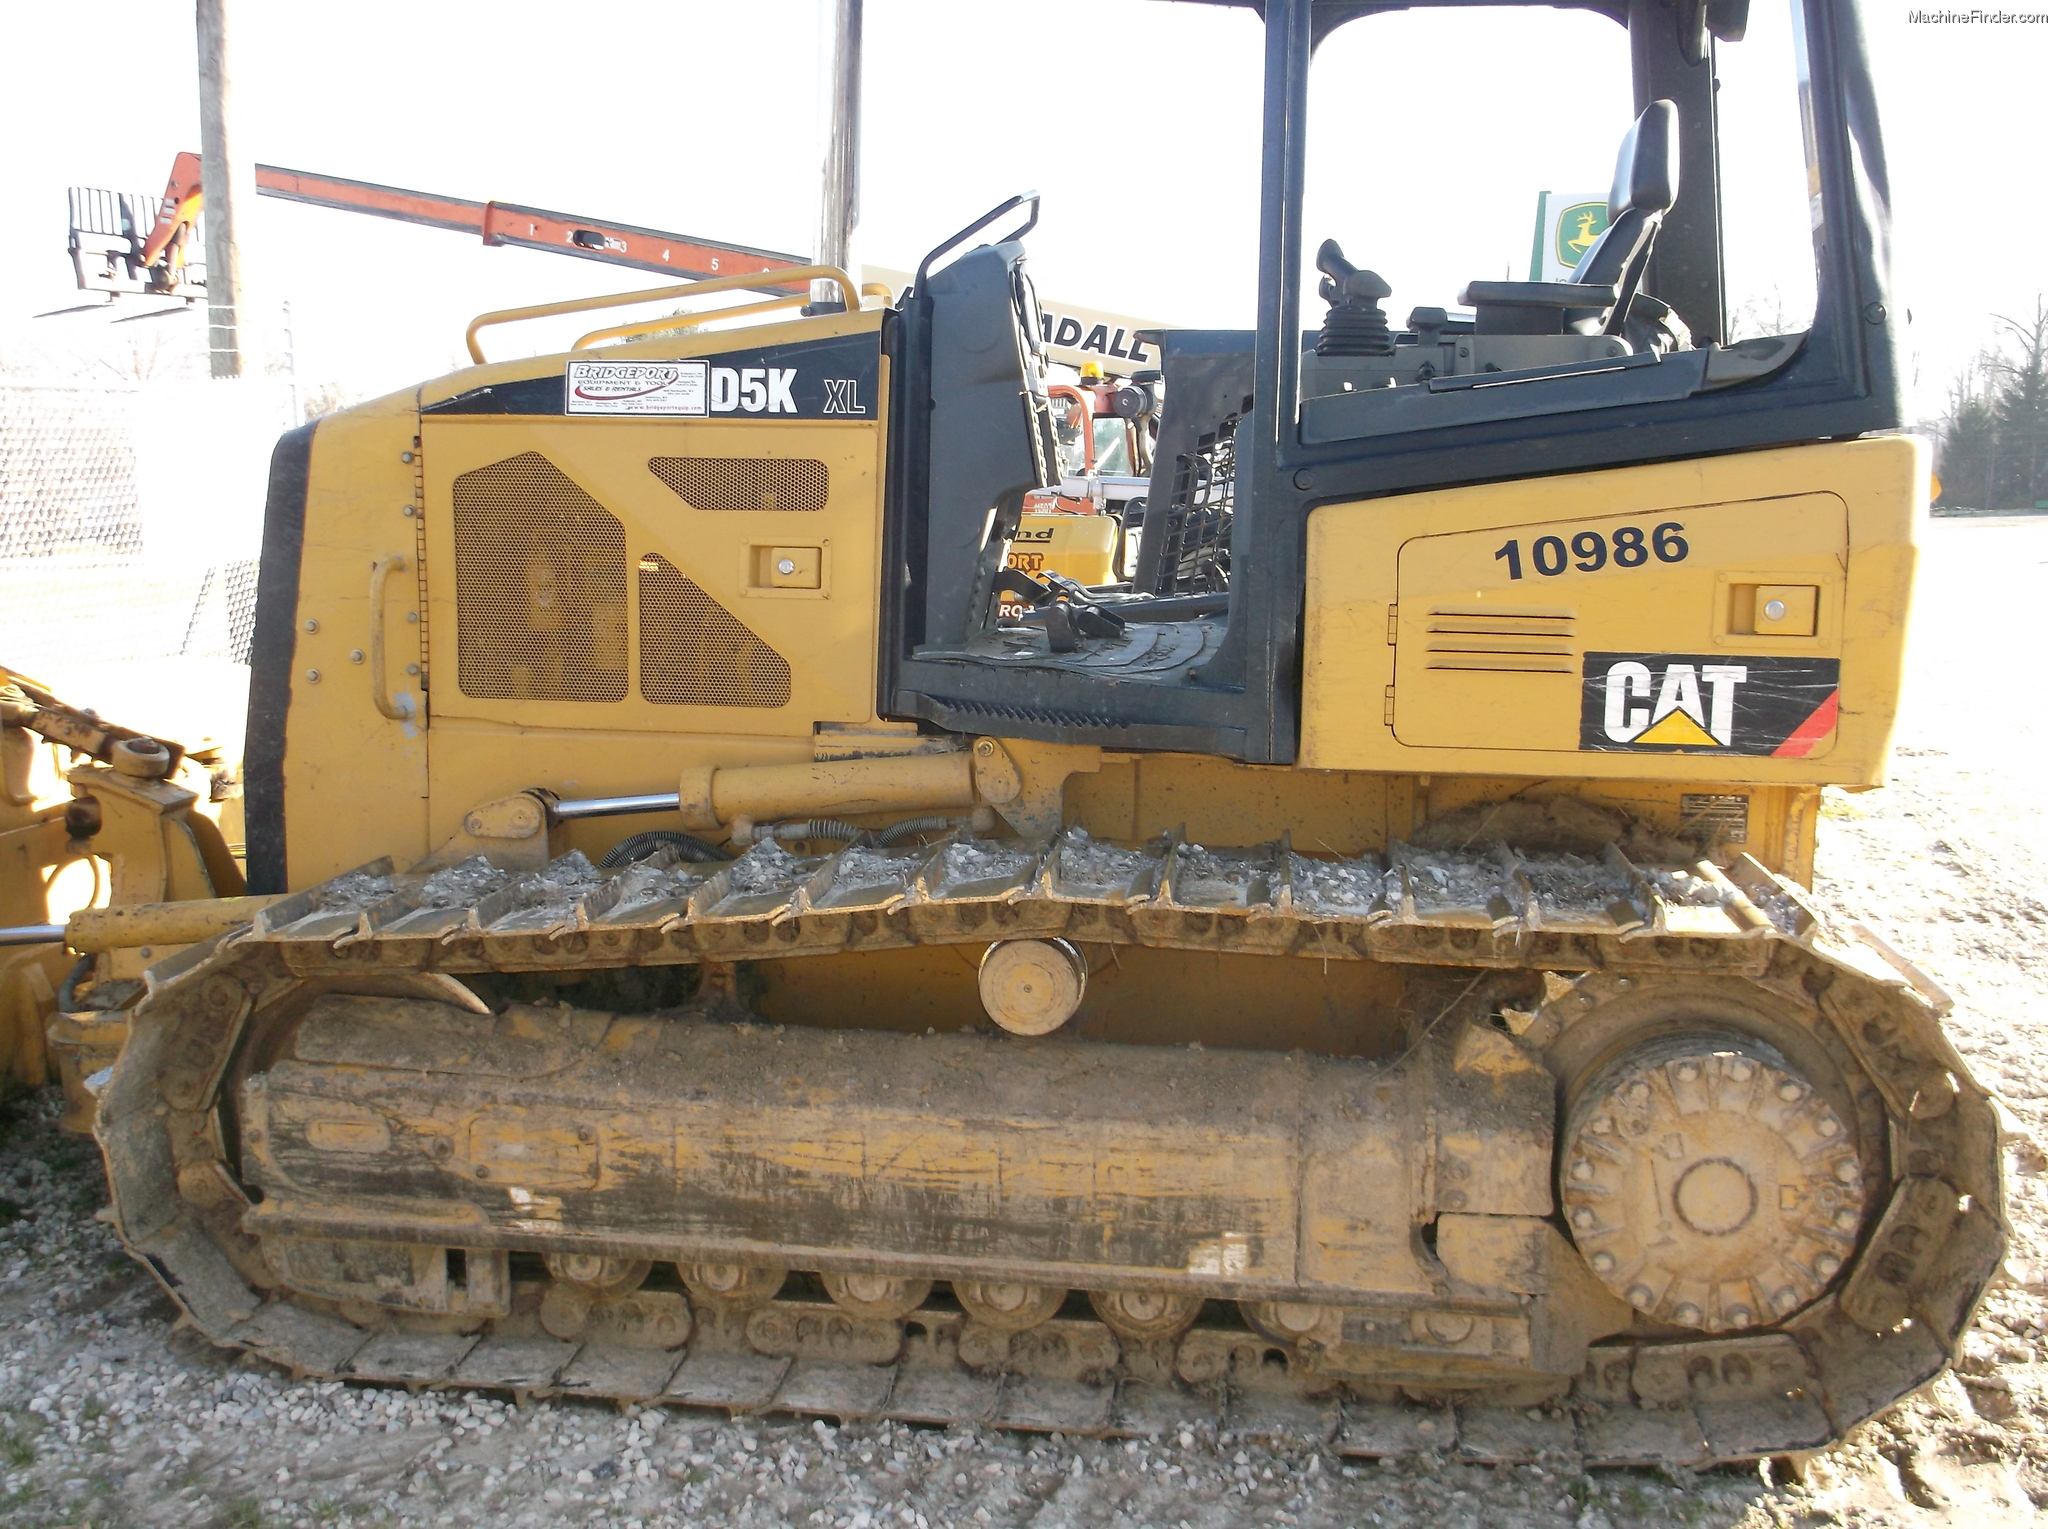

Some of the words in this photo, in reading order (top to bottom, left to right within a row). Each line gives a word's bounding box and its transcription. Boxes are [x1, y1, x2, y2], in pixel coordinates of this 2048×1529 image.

[566, 231, 574, 244] 2
[620, 240, 627, 253] 3
[662, 249, 670, 262] 4
[711, 258, 719, 271] 5
[574, 365, 678, 380] BRIDGEPORT
[711, 367, 798, 414] D5K
[823, 379, 866, 414] XL
[1494, 521, 1689, 580] 10986
[1603, 660, 1748, 747] CAT
